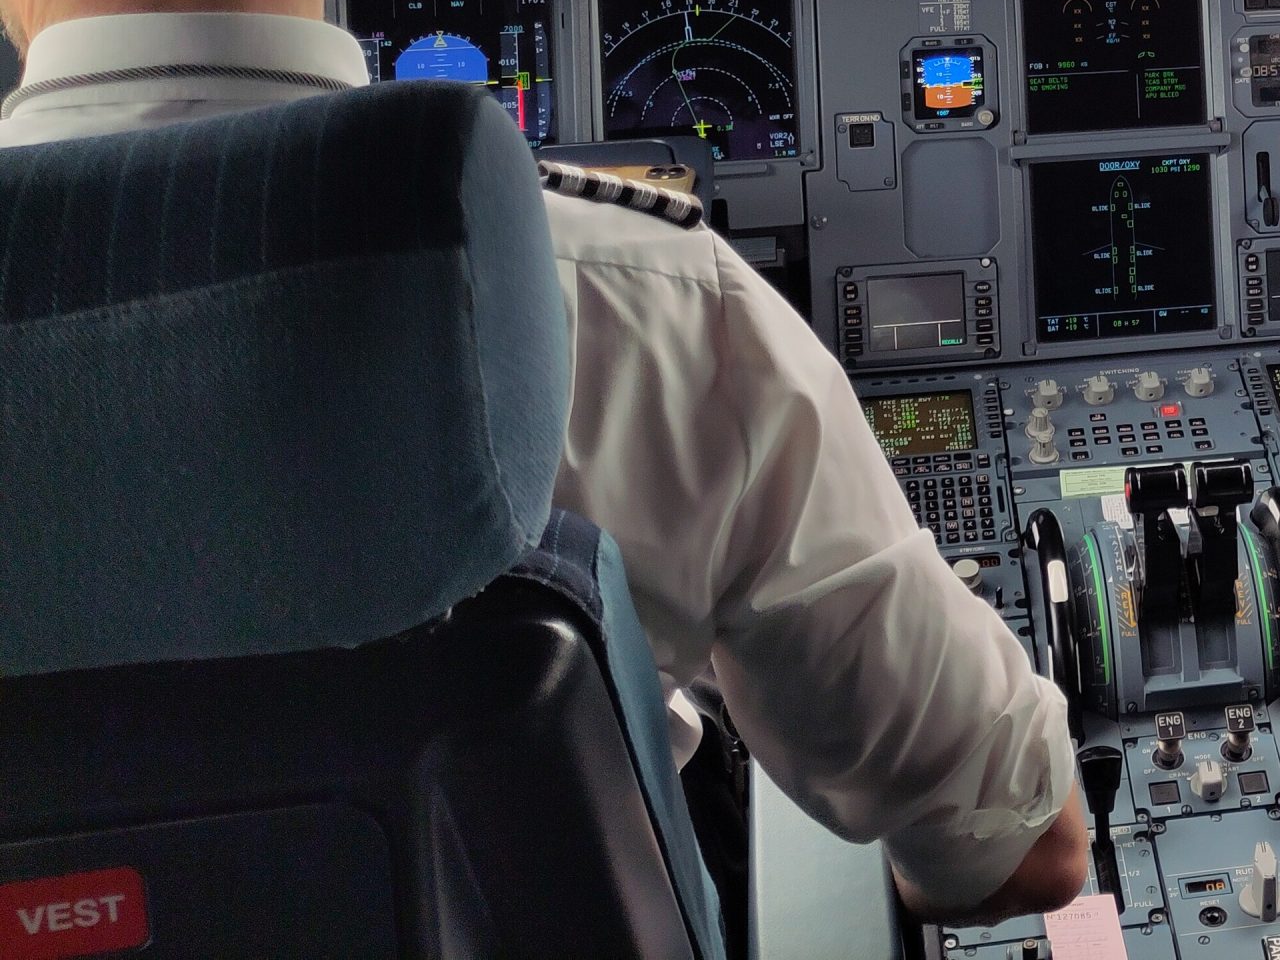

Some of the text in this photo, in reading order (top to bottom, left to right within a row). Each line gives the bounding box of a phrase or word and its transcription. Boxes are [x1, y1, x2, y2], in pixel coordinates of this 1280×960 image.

[661, 0, 672, 8] 18
[728, 0, 739, 7] 21
[770, 140, 784, 148] LSE
[1100, 161, 1140, 170] DOOR/OXY
[1184, 164, 1200, 172] 1290
[1235, 580, 1245, 608] REV
[1121, 592, 1130, 618] REV
[1228, 706, 1250, 719] ENG
[1158, 717, 1181, 726] ENG
[1238, 719, 1244, 729] 2
[1168, 727, 1173, 736] 1
[1188, 732, 1206, 740] ENG
[1235, 868, 1254, 876] RUD
[15, 893, 125, 935] VEST
